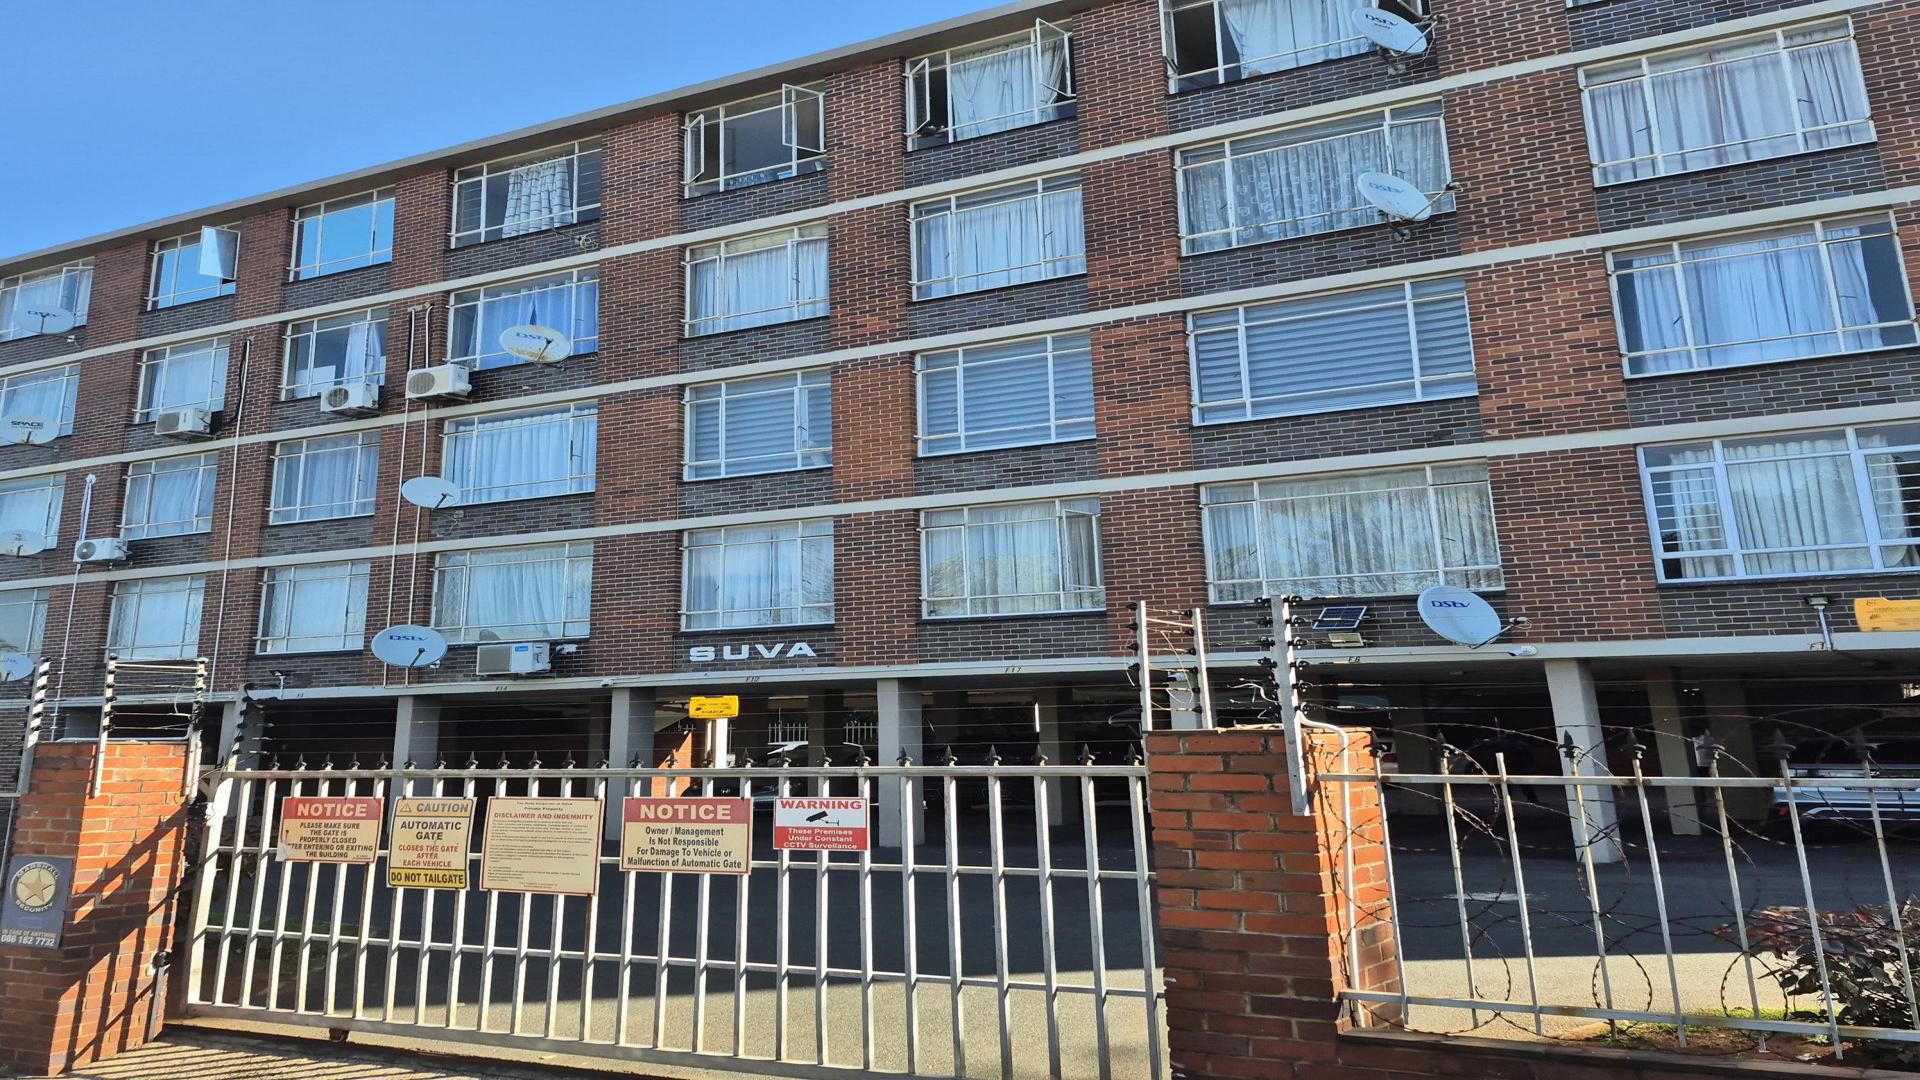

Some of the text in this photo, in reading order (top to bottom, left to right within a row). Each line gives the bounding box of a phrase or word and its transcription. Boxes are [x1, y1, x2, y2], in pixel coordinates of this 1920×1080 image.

[1431, 600, 1471, 608] DStv
[389, 634, 428, 642] DStv
[689, 642, 817, 662] SUVA
[296, 803, 368, 817] NOTICE
[416, 803, 469, 813] CAUTION
[780, 800, 862, 810] WARNING
[640, 804, 731, 820] NOTICE
[400, 821, 462, 830] AUTOMATIC
[416, 831, 444, 840] GATE
[645, 826, 669, 835] Owner
[674, 827, 724, 837] Management
[658, 837, 671, 845] Not
[673, 837, 719, 848] Responsible
[398, 844, 424, 852] CLOSES
[637, 847, 648, 855] For
[650, 847, 680, 857] Damage
[682, 848, 691, 856] To
[693, 848, 721, 857] Vehicle
[627, 857, 742, 868] Malfunction of Automatic Gate
[391, 872, 464, 884] DO NOT TAILGATE
[16, 899, 53, 913] SECURITY
